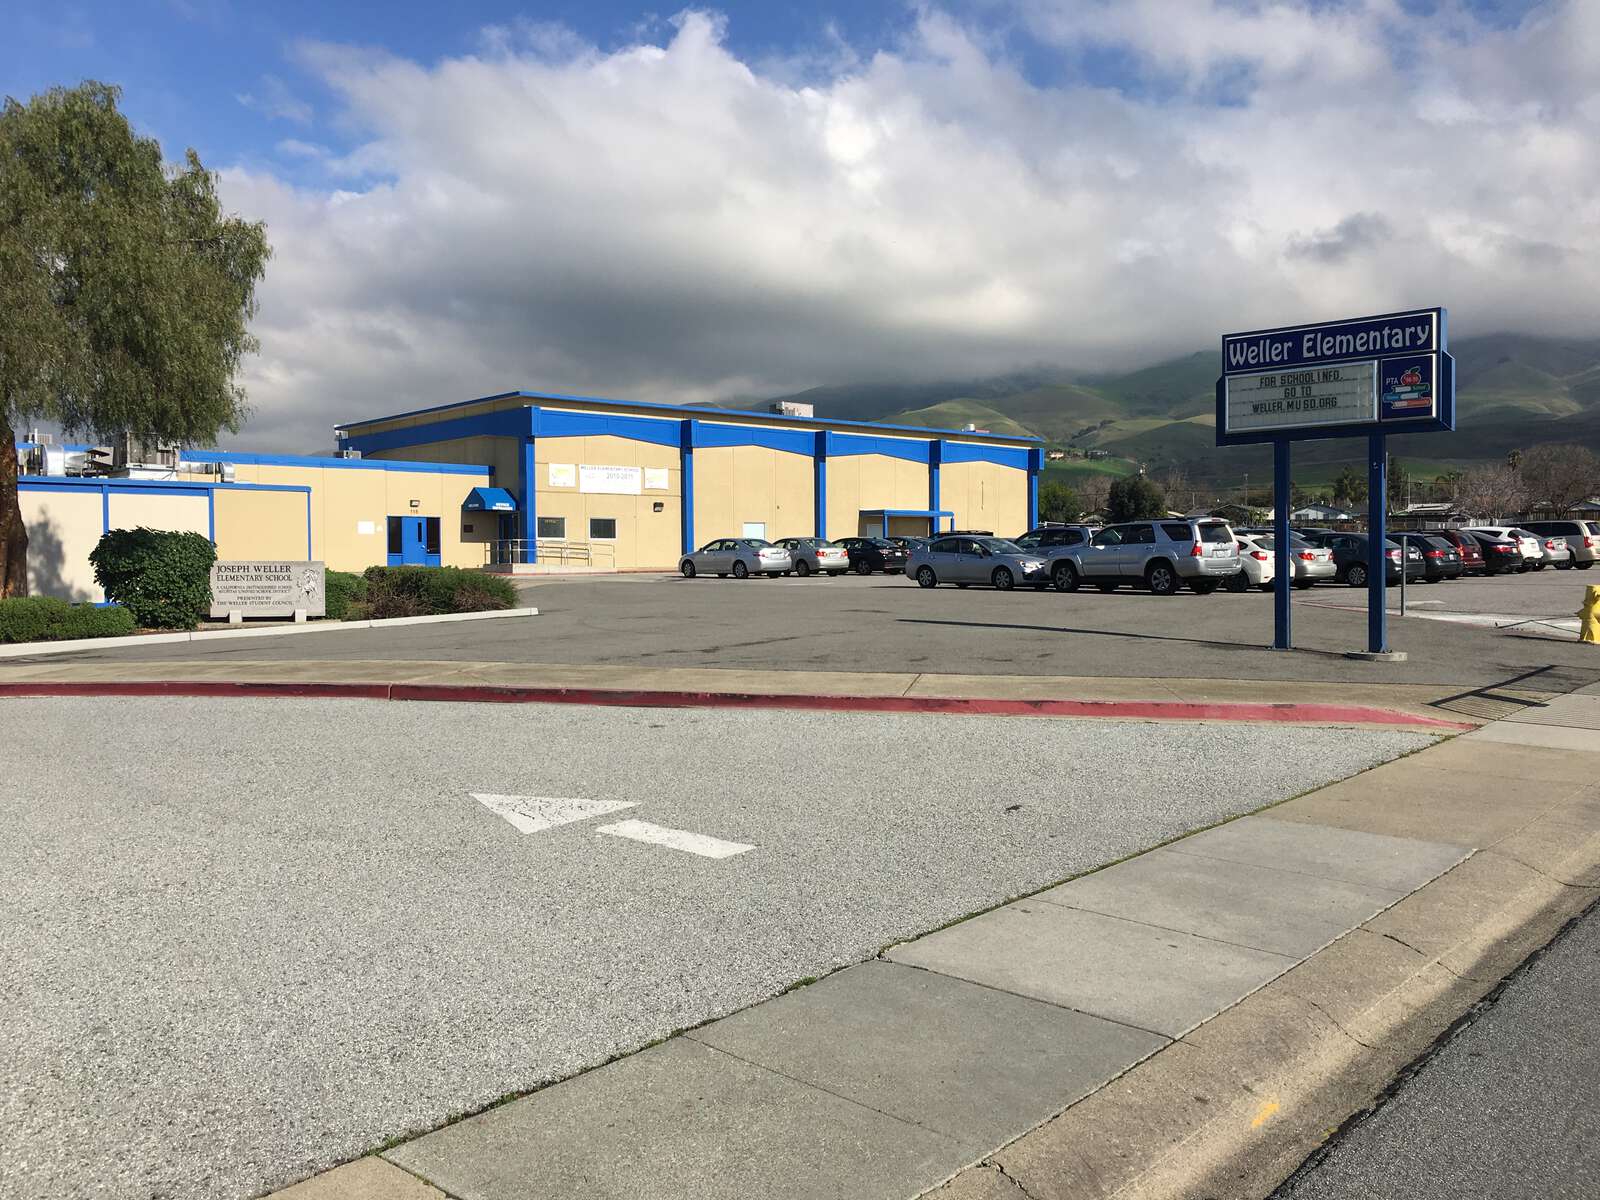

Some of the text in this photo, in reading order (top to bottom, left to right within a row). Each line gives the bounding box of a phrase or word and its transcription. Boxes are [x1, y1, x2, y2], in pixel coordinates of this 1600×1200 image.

[1228, 324, 1430, 367] Weller Elementary
[1260, 376, 1277, 388] FOR
[1280, 373, 1318, 386] SCHOOL
[1385, 377, 1399, 386] PTA
[1284, 386, 1312, 398] GO TO
[215, 565, 292, 574] JOSEPH WELLER
[216, 574, 293, 582] ELEMENTARY SCHOOL
